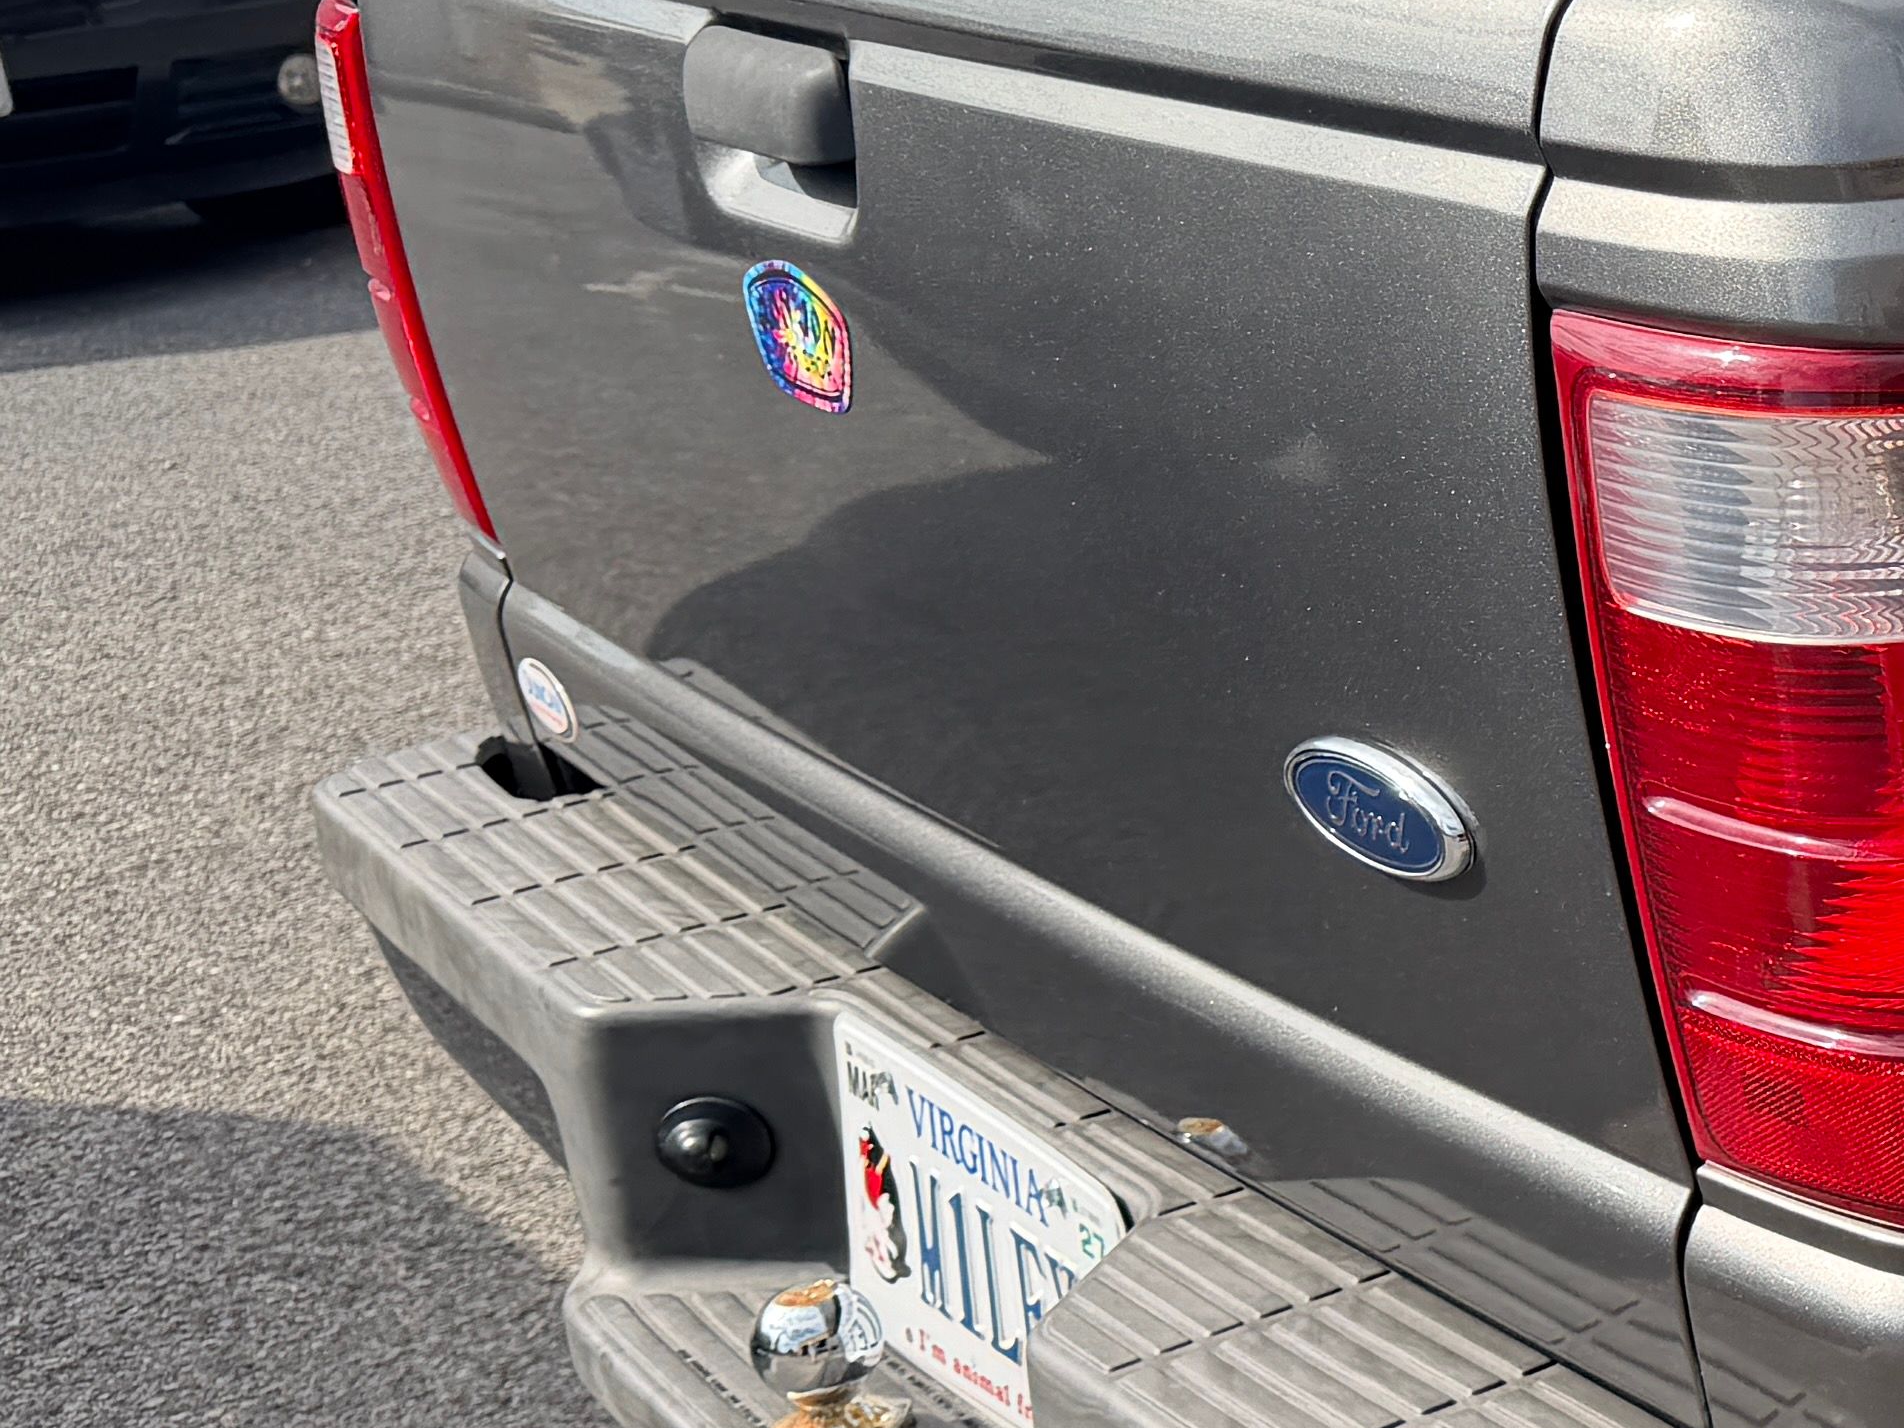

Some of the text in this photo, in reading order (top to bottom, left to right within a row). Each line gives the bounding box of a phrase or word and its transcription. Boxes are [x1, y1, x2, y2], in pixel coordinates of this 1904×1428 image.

[1326, 770, 1410, 855] Ford
[905, 1085, 1049, 1227] VIRGINIA
[1079, 1223, 1105, 1259] 27
